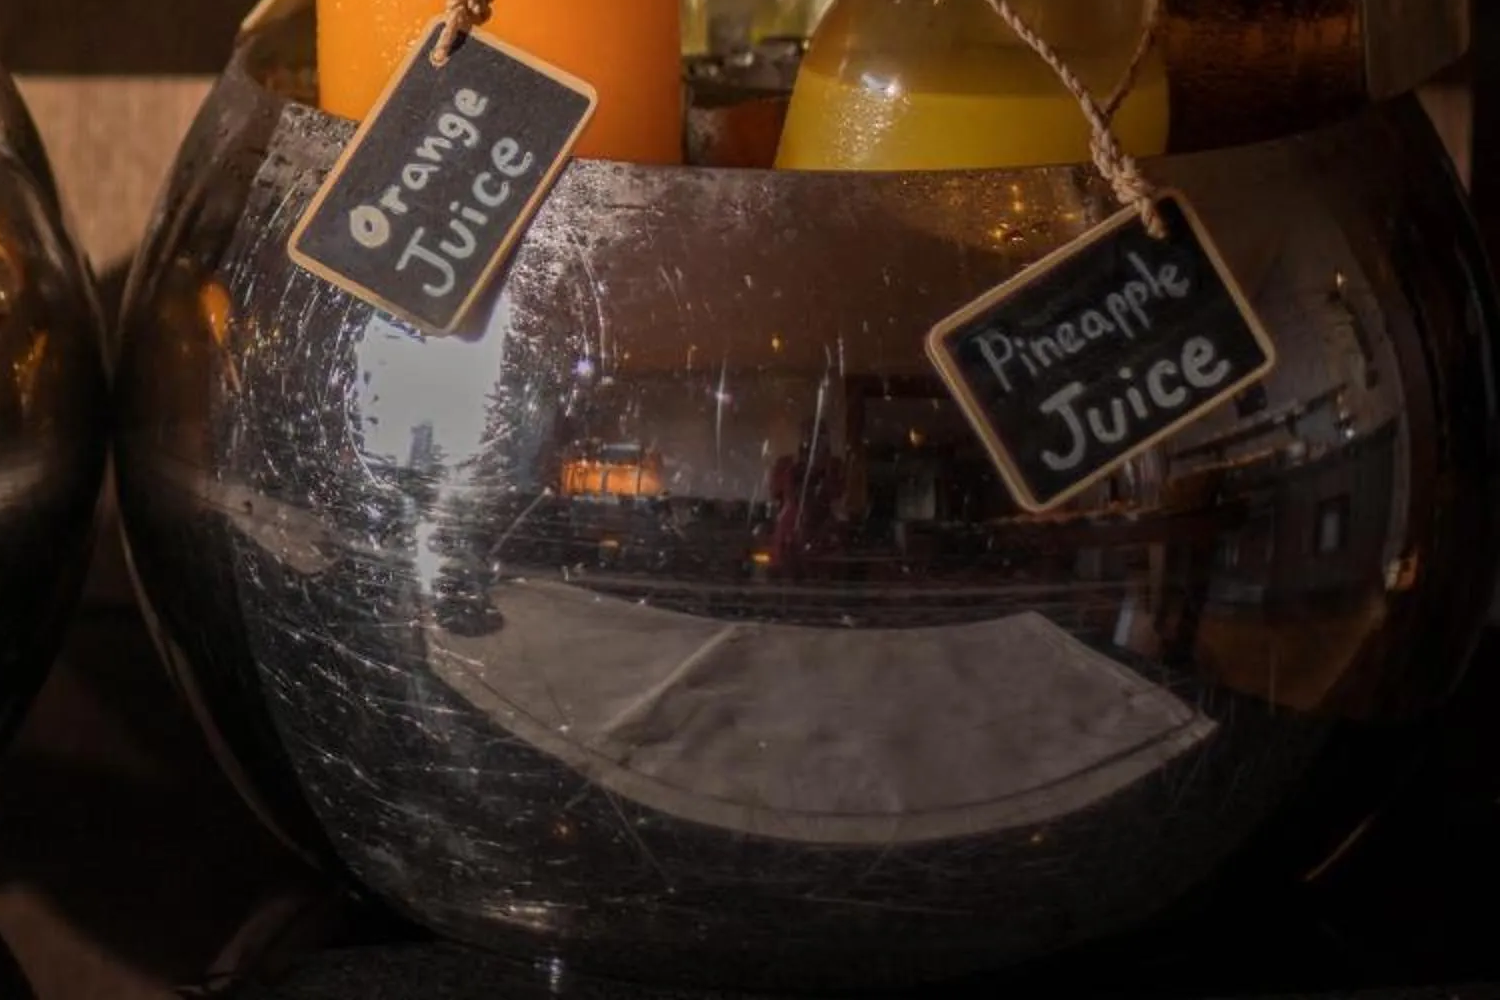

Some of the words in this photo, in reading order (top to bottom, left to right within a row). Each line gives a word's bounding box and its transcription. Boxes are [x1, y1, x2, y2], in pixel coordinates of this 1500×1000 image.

[349, 87, 488, 249] Orange
[395, 137, 534, 297] Juice
[974, 252, 1190, 393] Pineapple
[1040, 336, 1231, 470] Juice
